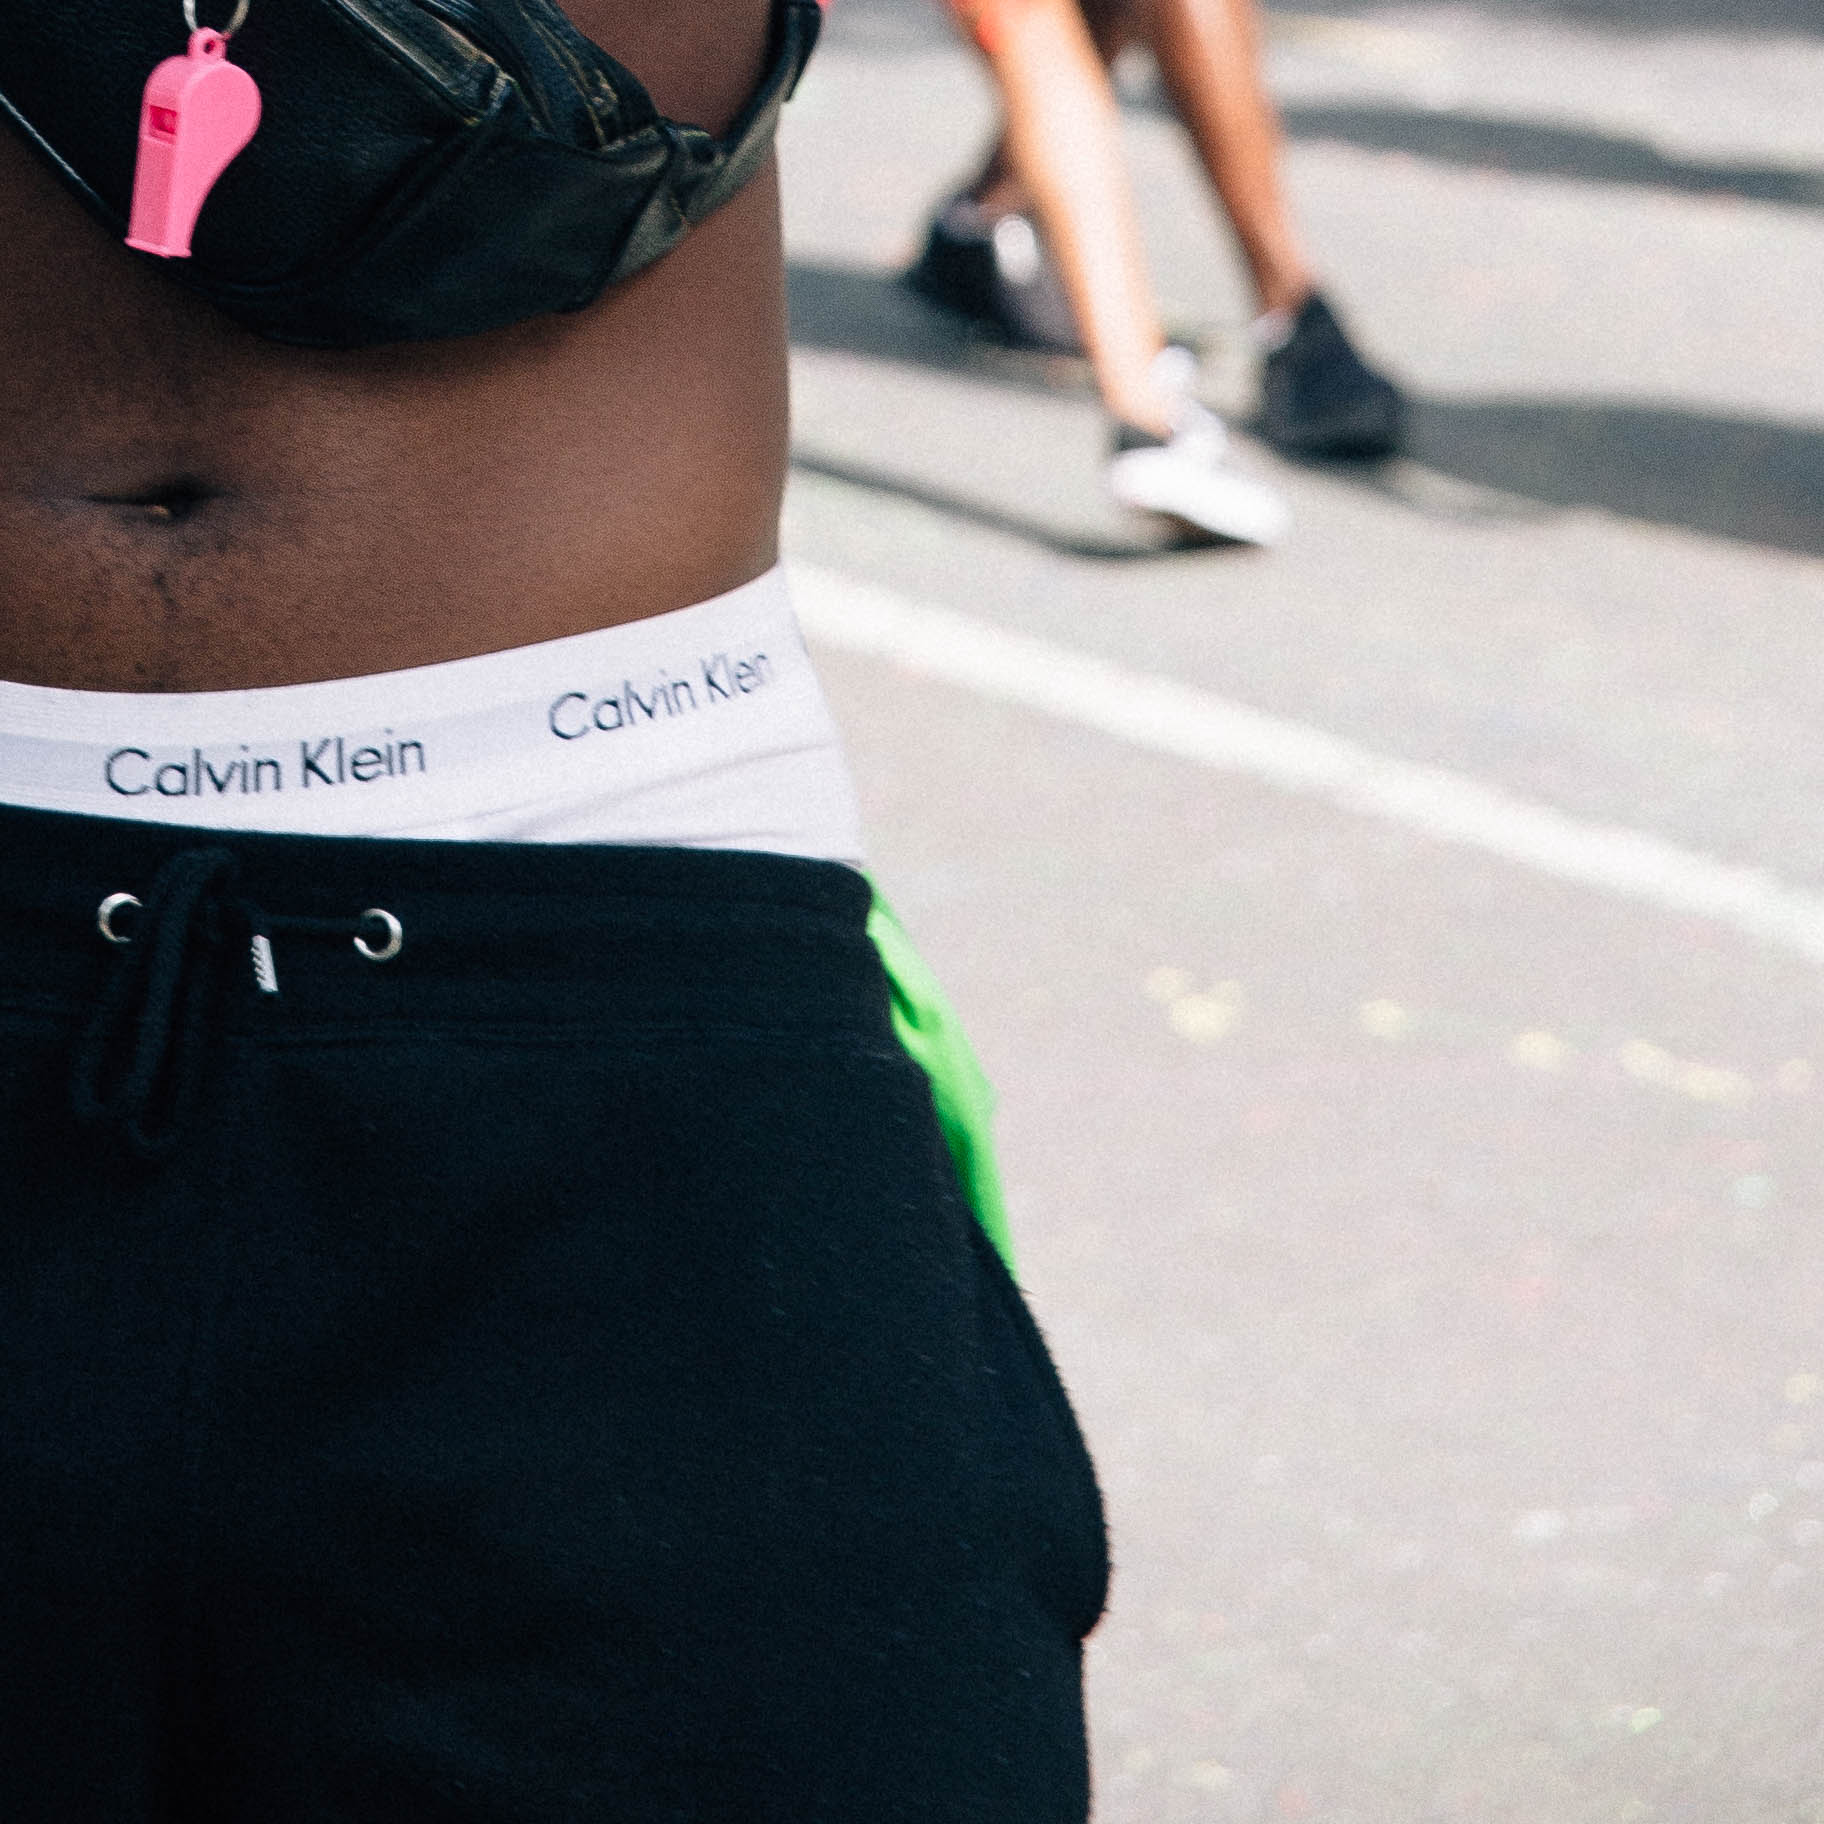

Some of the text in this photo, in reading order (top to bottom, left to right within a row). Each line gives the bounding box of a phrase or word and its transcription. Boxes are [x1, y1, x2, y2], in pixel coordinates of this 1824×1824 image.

[547, 668, 698, 741] Calvin
[105, 728, 426, 797] Calvin Klein
